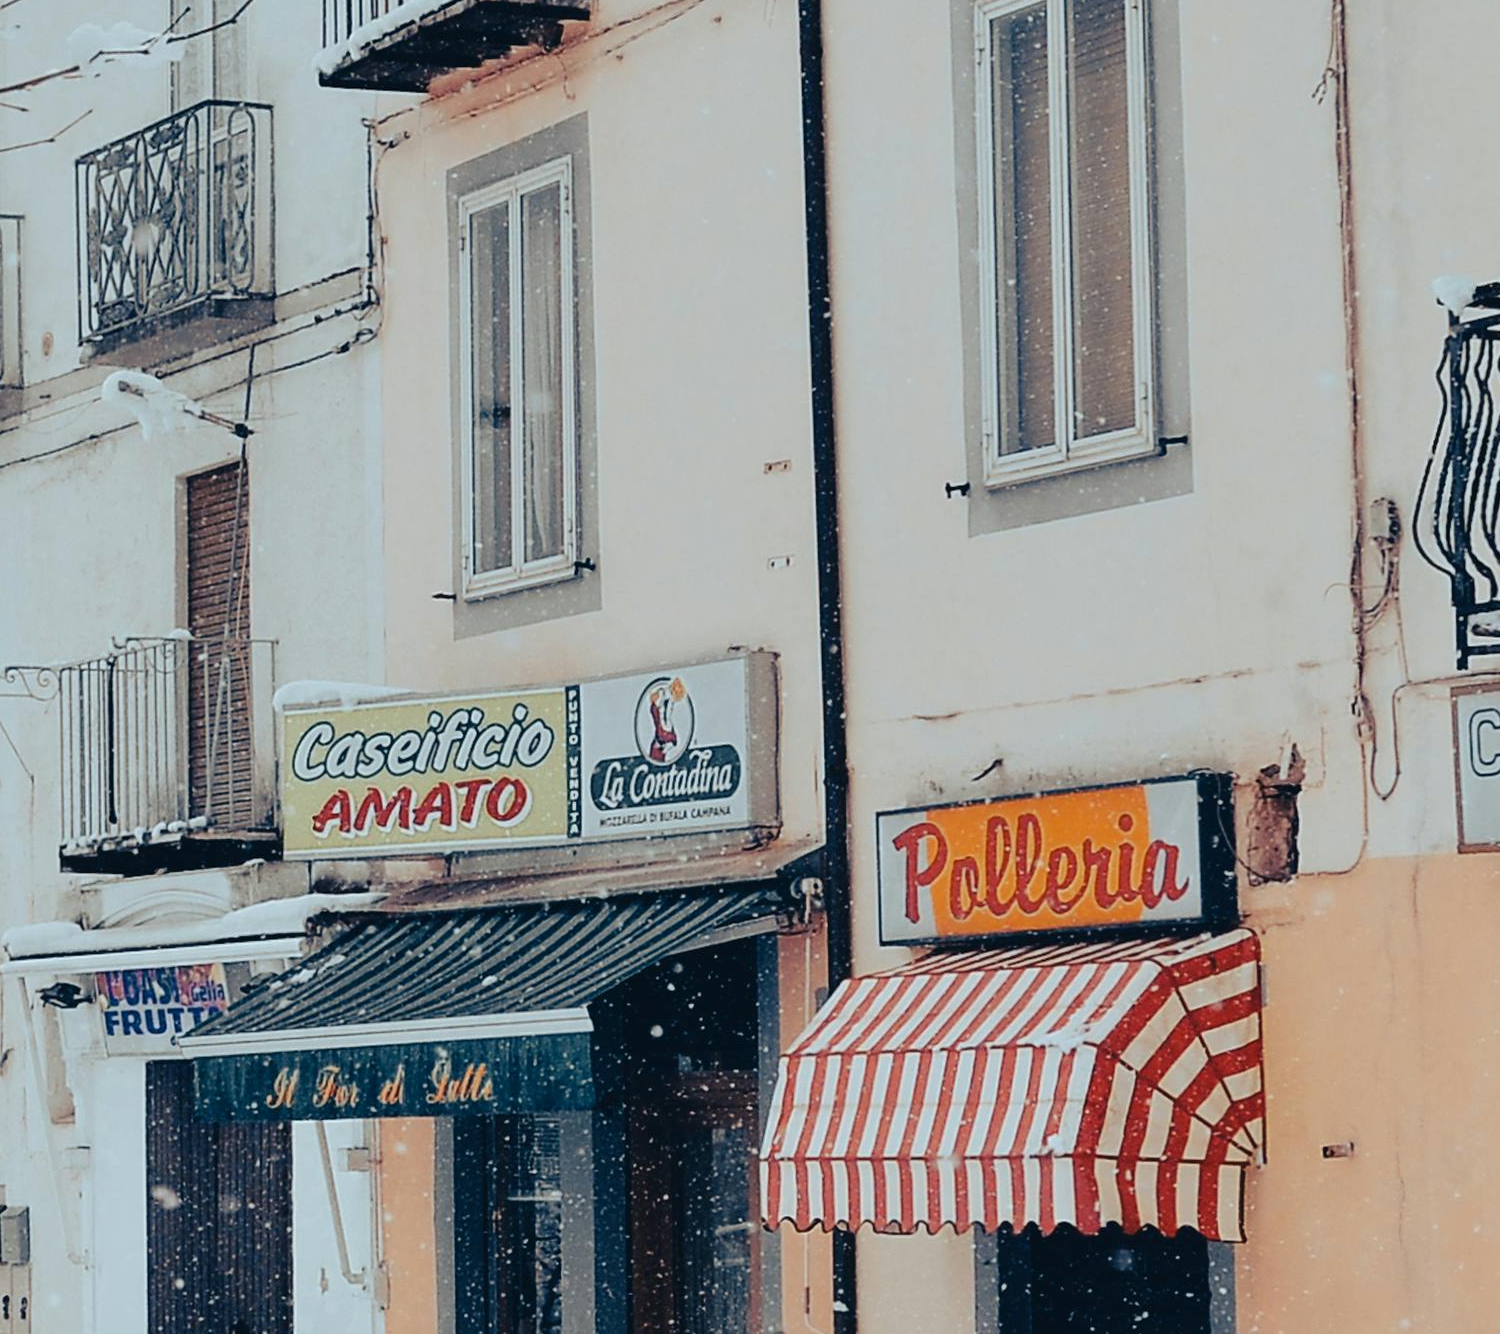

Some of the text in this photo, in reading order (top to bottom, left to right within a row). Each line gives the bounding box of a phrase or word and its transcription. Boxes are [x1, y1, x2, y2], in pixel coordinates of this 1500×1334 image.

[292, 702, 555, 782] Caseificio
[567, 689, 581, 835] PUNTO VENDITA
[311, 776, 532, 839] AMATO
[599, 749, 733, 808] La Contadina
[691, 806, 731, 819] CAMPANA
[892, 812, 1190, 924] Polleria
